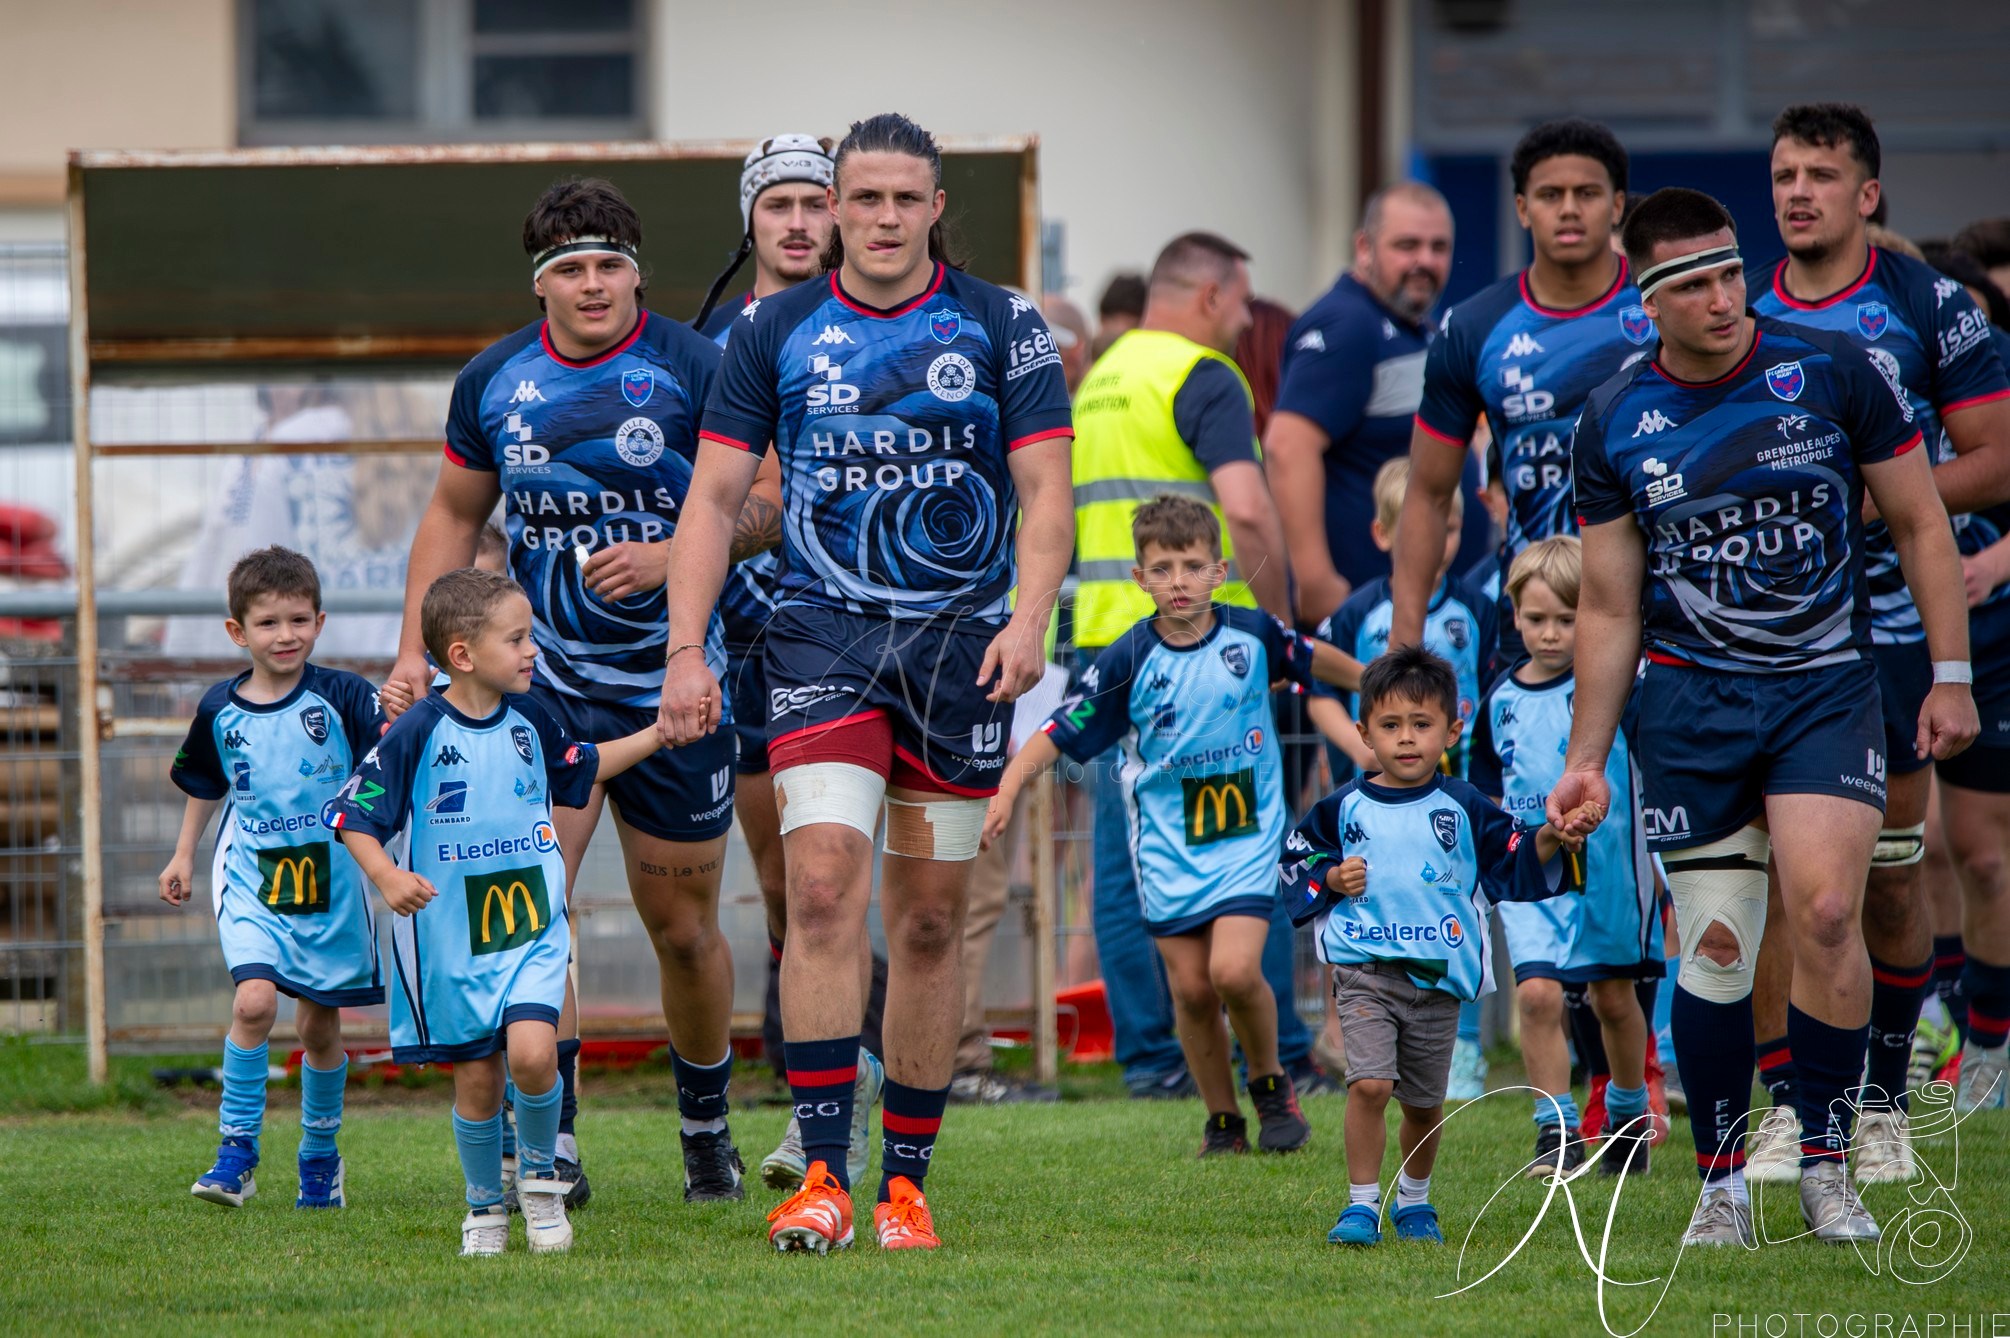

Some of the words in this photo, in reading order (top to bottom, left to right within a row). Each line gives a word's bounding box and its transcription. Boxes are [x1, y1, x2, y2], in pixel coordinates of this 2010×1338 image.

[931, 355, 955, 374] VILLE
[957, 357, 970, 371] DE
[807, 385, 860, 405] SD
[930, 376, 974, 400] GRENOBLE
[807, 405, 859, 415] SERVICES
[1502, 390, 1555, 418] SD
[619, 419, 644, 437] VILLE
[647, 423, 661, 438] DE
[812, 423, 976, 457] HARDIS
[504, 445, 550, 467] SD
[618, 441, 662, 464] GRENOBLE
[1771, 447, 1834, 471] MÉTROPOLE
[506, 466, 551, 475] SERVICES
[817, 461, 966, 492] GROUP
[1645, 473, 1683, 498] SD
[1649, 487, 1685, 504] SERVICES
[513, 487, 676, 516] HARDIS
[1656, 483, 1830, 544] HARDIS
[522, 520, 663, 551] GROUP
[336, 774, 386, 812] AZ
[429, 816, 472, 825] CHAMBARD
[438, 837, 531, 863] E.Leclerc
[793, 1102, 840, 1119] CG
